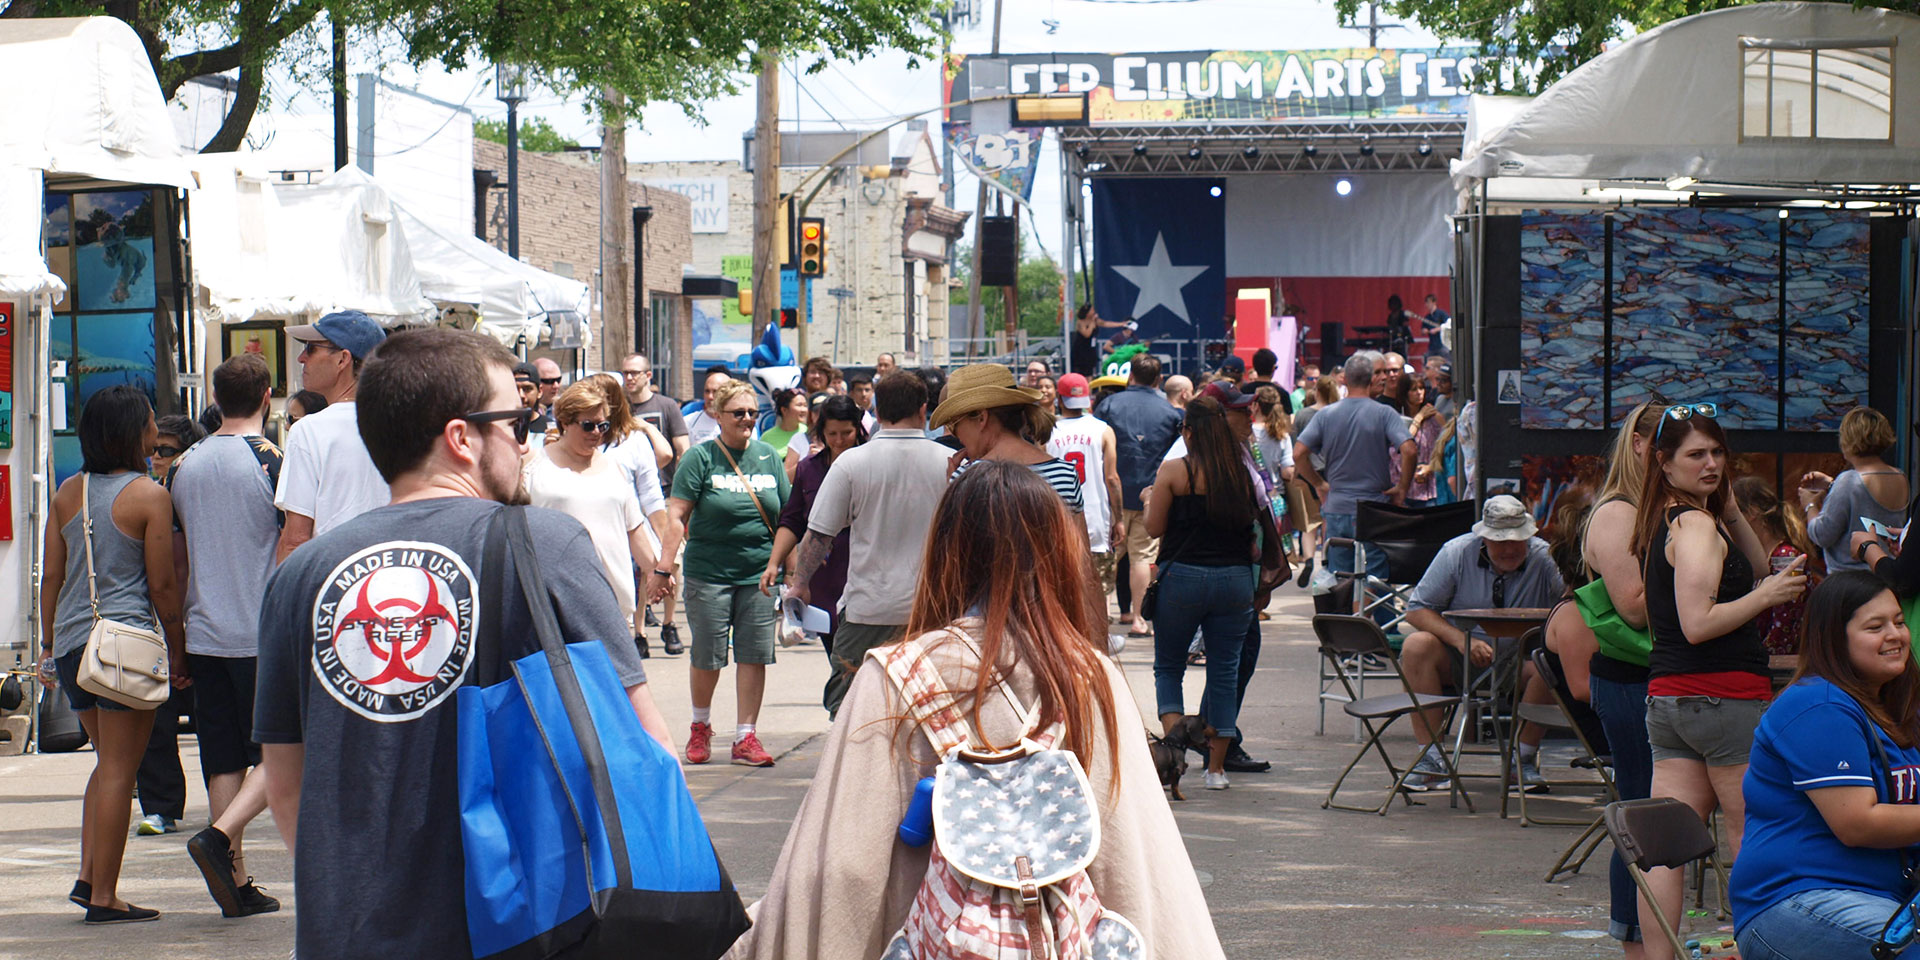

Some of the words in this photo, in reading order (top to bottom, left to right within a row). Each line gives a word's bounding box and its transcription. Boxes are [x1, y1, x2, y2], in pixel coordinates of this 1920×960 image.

[1011, 62, 1100, 94] EEP
[1113, 56, 1263, 101] ELLUM
[1274, 54, 1386, 99] ARTS
[660, 183, 714, 202] TCH
[1055, 434, 1092, 449] PIPPEN
[334, 551, 394, 592] MADE
[400, 550, 425, 567] IN
[428, 555, 461, 585] USA
[316, 600, 338, 642] USA
[453, 598, 473, 661] MADE
[319, 646, 340, 672] IN
[436, 662, 461, 685] IN
[331, 671, 385, 711] MADE
[399, 684, 437, 710] USA
